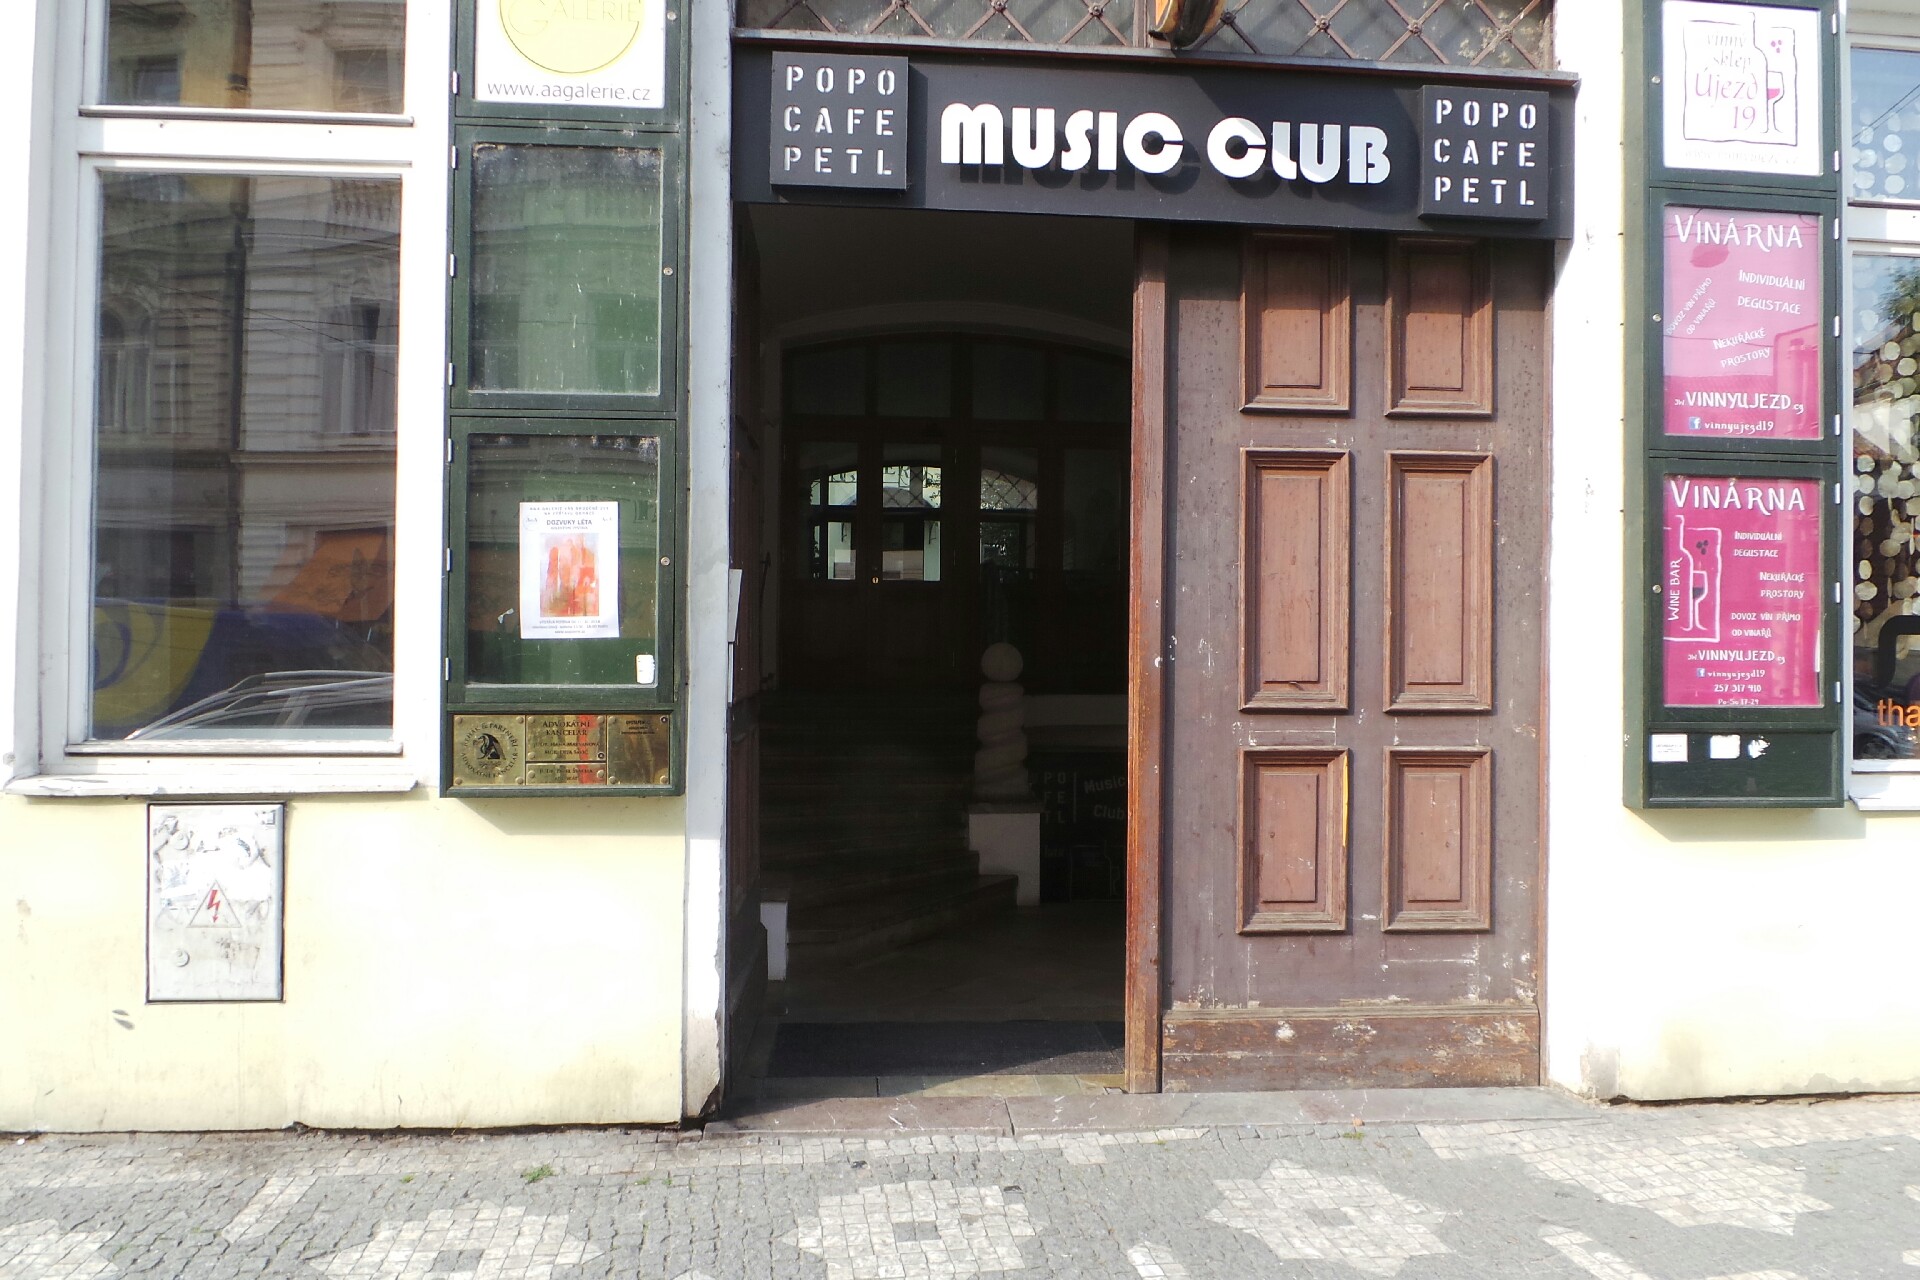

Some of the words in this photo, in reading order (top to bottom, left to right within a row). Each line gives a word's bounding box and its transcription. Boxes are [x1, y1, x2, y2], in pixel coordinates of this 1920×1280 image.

[487, 83, 651, 101] www.aagalerie.cz
[786, 65, 896, 96] POPO
[783, 105, 894, 136] CAFE
[1436, 99, 1537, 130] POPO
[1733, 106, 1756, 130] 19
[940, 103, 1184, 175] MUSIC
[1206, 117, 1391, 184] CLUB
[1434, 138, 1535, 168] CAFE
[783, 145, 892, 176] PETL
[1434, 176, 1534, 206] PETL
[1674, 214, 1803, 252] VINÁRNA
[1737, 296, 1801, 315] DEGUSTACE
[1720, 347, 1771, 368] PROSTORY
[1670, 480, 1805, 516] VINÁRNA
[577, 517, 593, 526] LÉTA
[1733, 548, 1779, 557] DEGUSTACE
[1669, 557, 1683, 585] BAR
[1667, 589, 1680, 621] WINE
[1760, 589, 1805, 599] PROSTORY
[1731, 612, 1757, 621] DOVOZ
[1731, 628, 1742, 637] OD
[1713, 684, 1730, 693] 257
